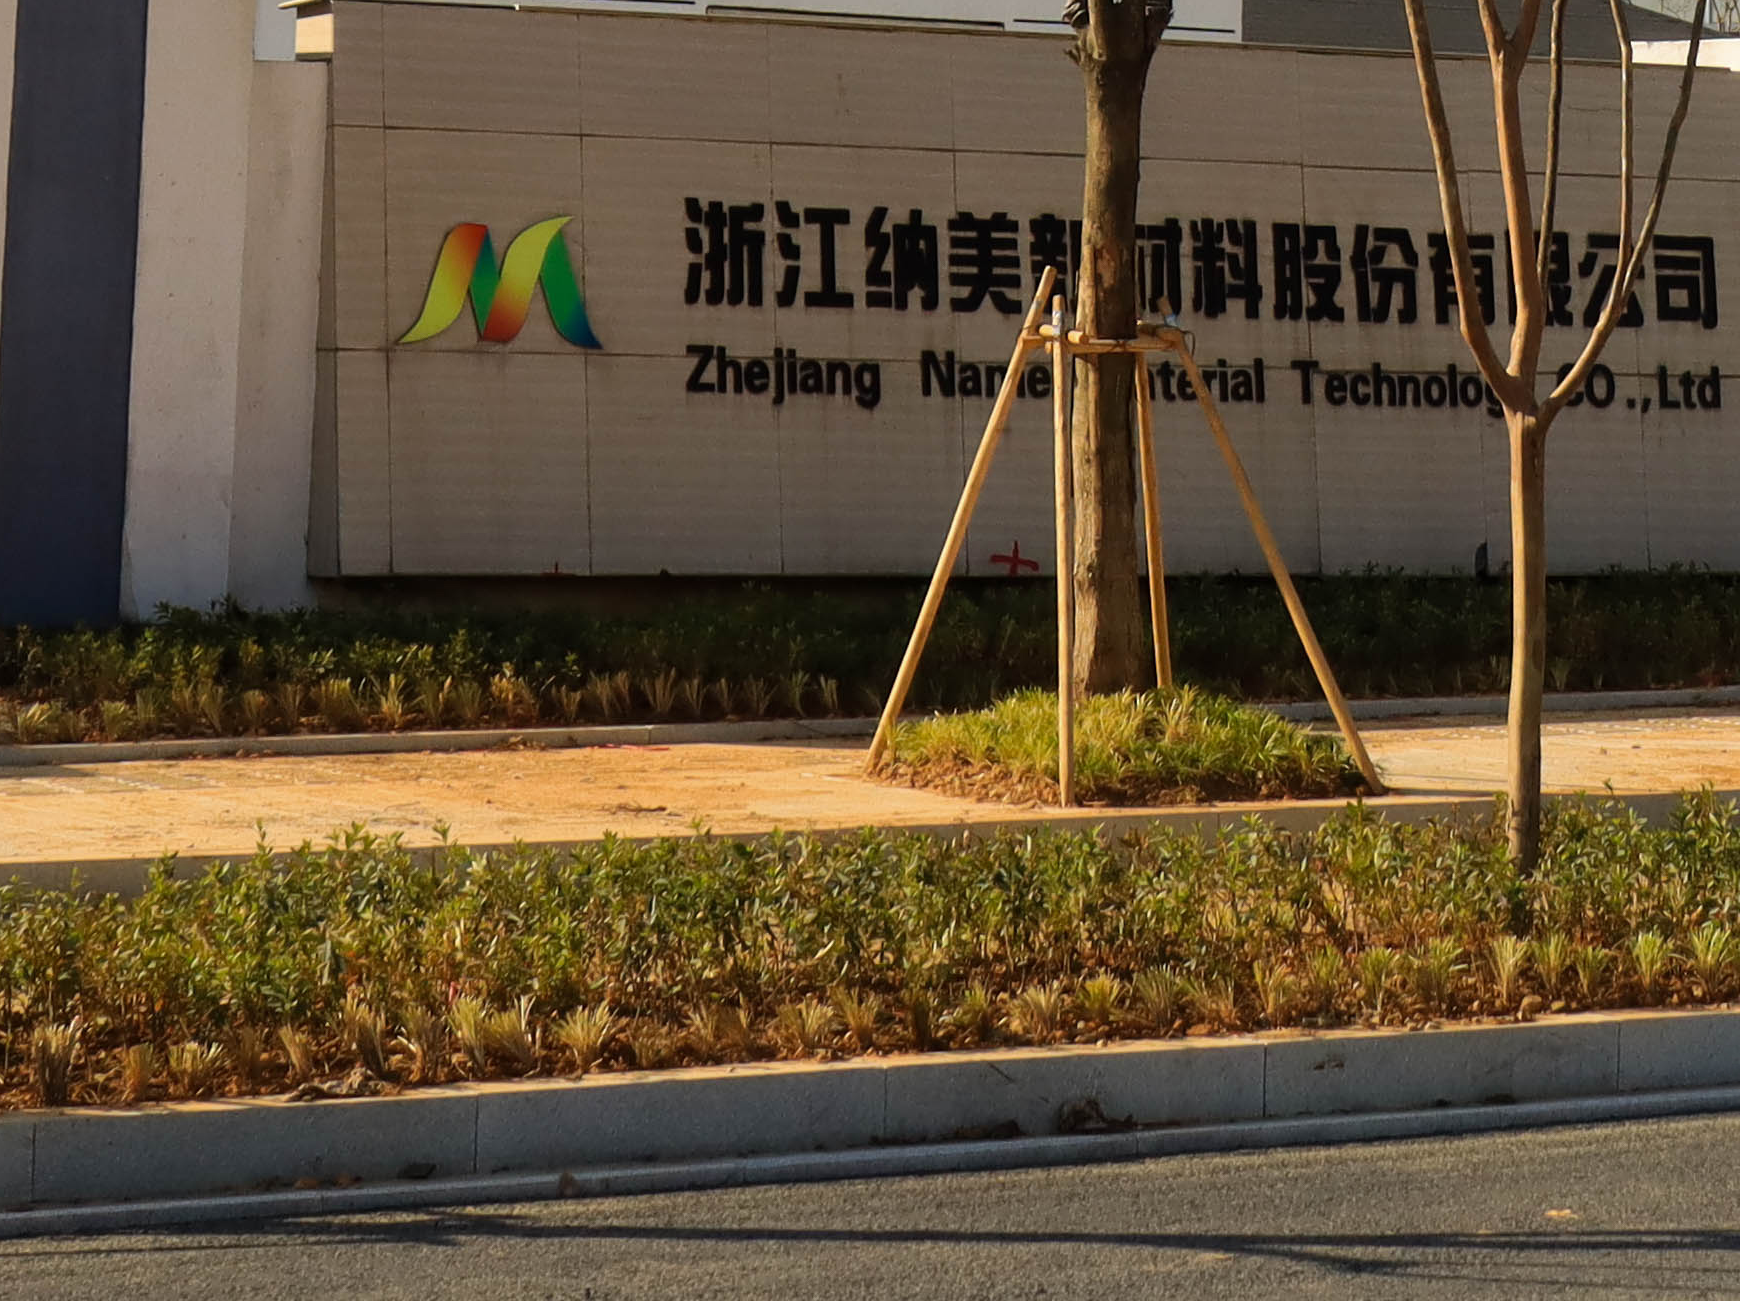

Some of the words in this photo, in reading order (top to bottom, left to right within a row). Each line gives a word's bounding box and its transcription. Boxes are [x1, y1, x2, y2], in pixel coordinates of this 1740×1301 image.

[685, 344, 881, 409] Zhejiang
[921, 349, 1052, 398] Name
[1291, 360, 1506, 419] Technolo
